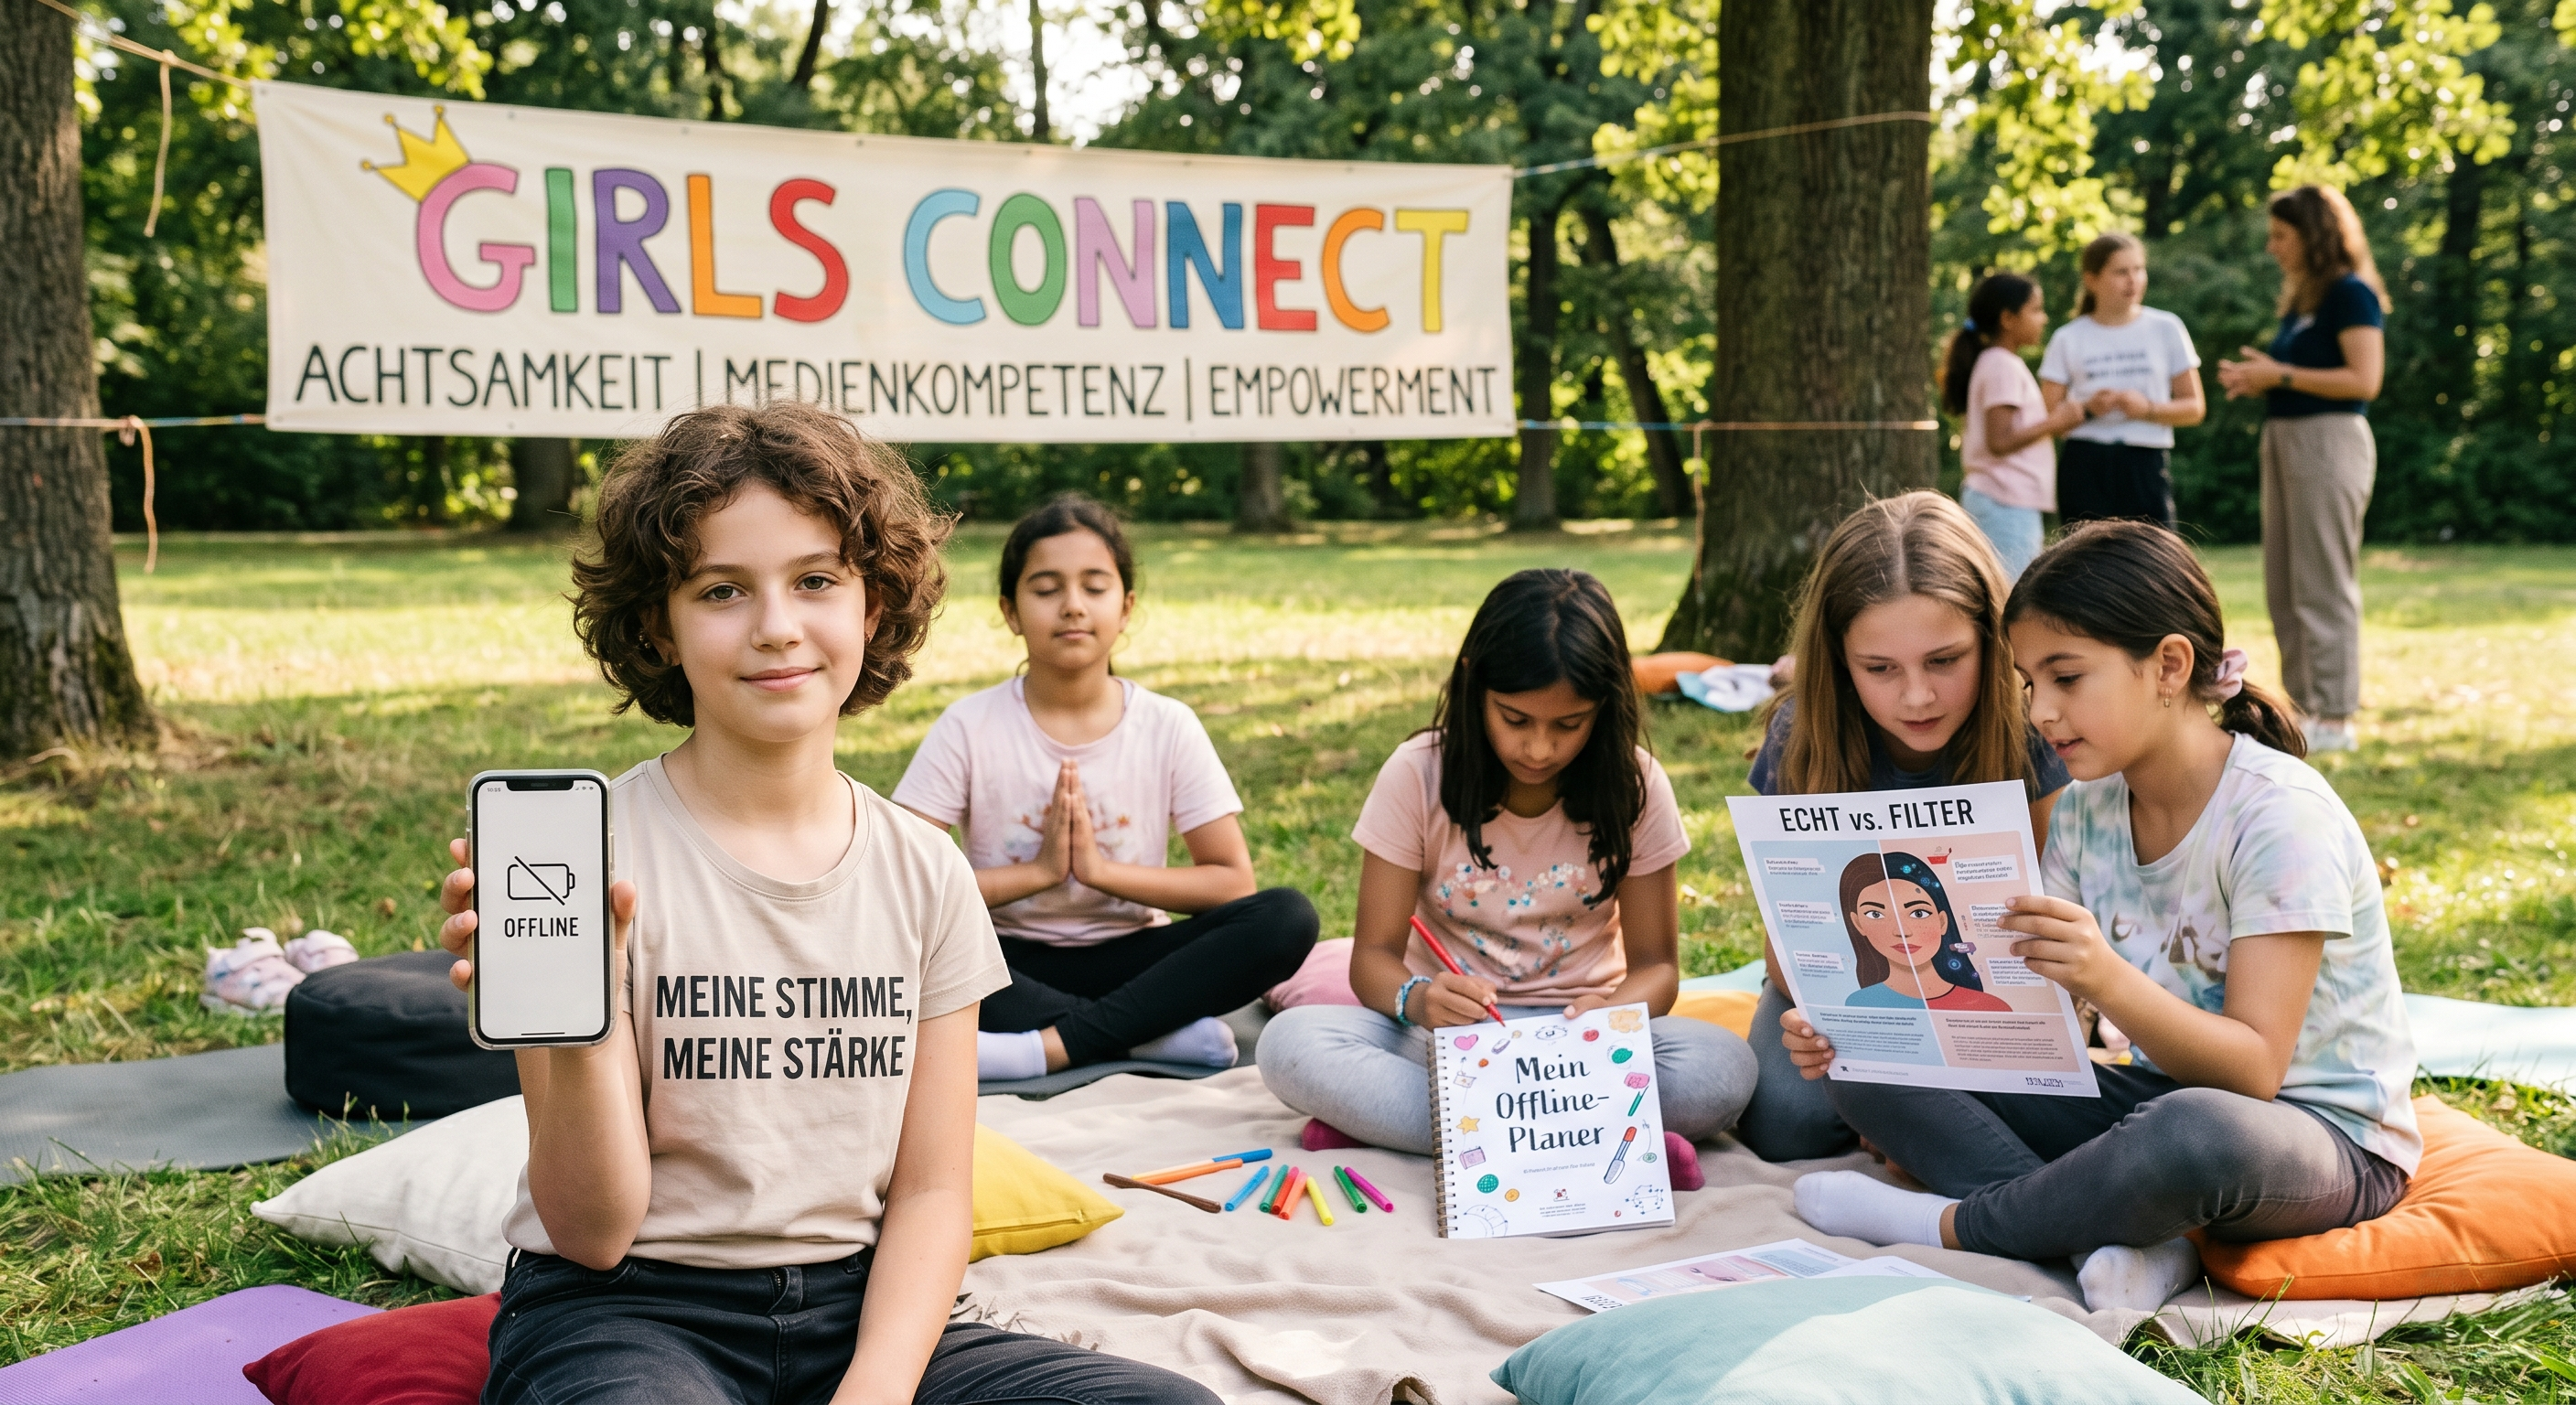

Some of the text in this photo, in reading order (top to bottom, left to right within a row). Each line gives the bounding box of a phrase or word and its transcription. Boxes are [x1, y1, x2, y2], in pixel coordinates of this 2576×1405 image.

[416, 162, 1469, 334] GIRLS CONNECT
[295, 344, 672, 410] ACHTSAMKEIT
[726, 358, 1166, 417] MEDIENKOMPETENZ
[1209, 365, 1497, 417] EMPOWERMENT
[1778, 798, 1975, 832] ECHT vs. FILTER
[504, 917, 579, 938] OFFLINE
[656, 975, 912, 1024] MEINE STIMME,
[663, 1028, 906, 1080] MEINE STÄRKE
[1515, 1053, 1591, 1084] Mein
[1496, 1089, 1610, 1121] Offline-
[1508, 1125, 1605, 1153] Planer
